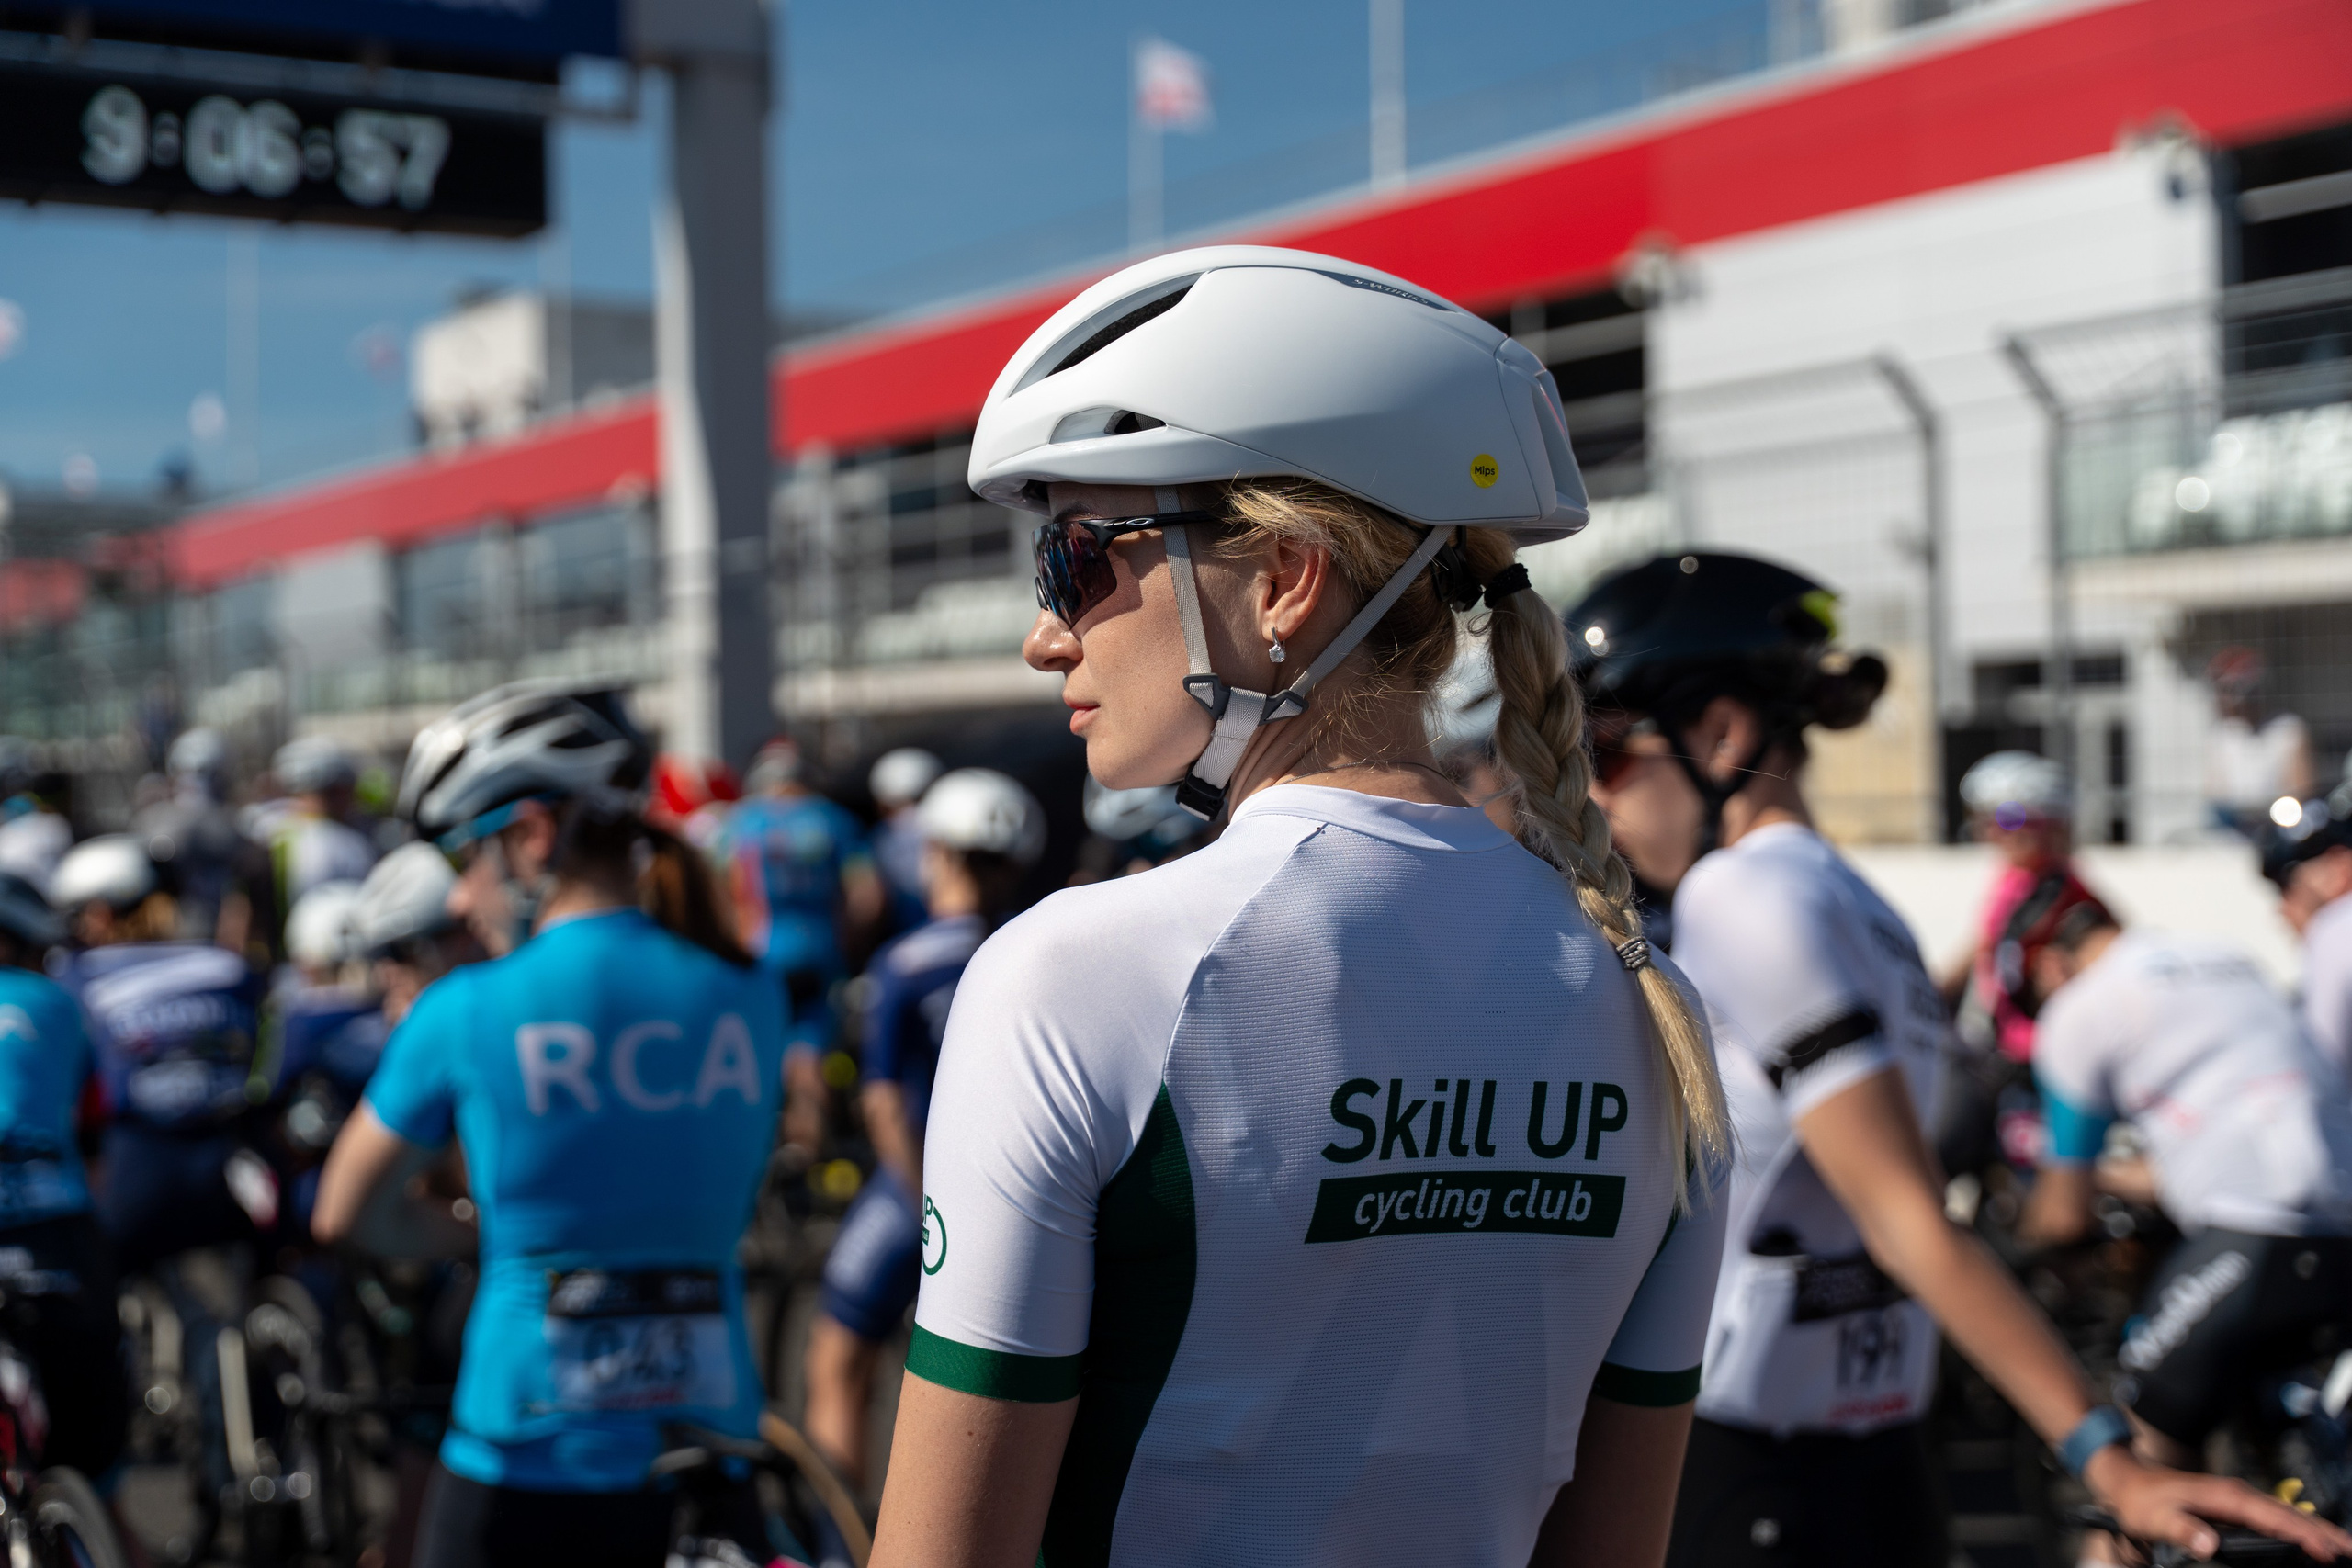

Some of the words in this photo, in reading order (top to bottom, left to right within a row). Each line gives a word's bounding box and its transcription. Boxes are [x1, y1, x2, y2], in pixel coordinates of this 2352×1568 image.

[80, 85, 451, 211] 9:06:57
[1474, 465, 1496, 477] Mips
[514, 1012, 762, 1117] RCA
[1320, 1077, 1497, 1163] Skill
[1527, 1081, 1628, 1160] UP
[1354, 1179, 1492, 1233] cycling
[1503, 1179, 1592, 1222] club
